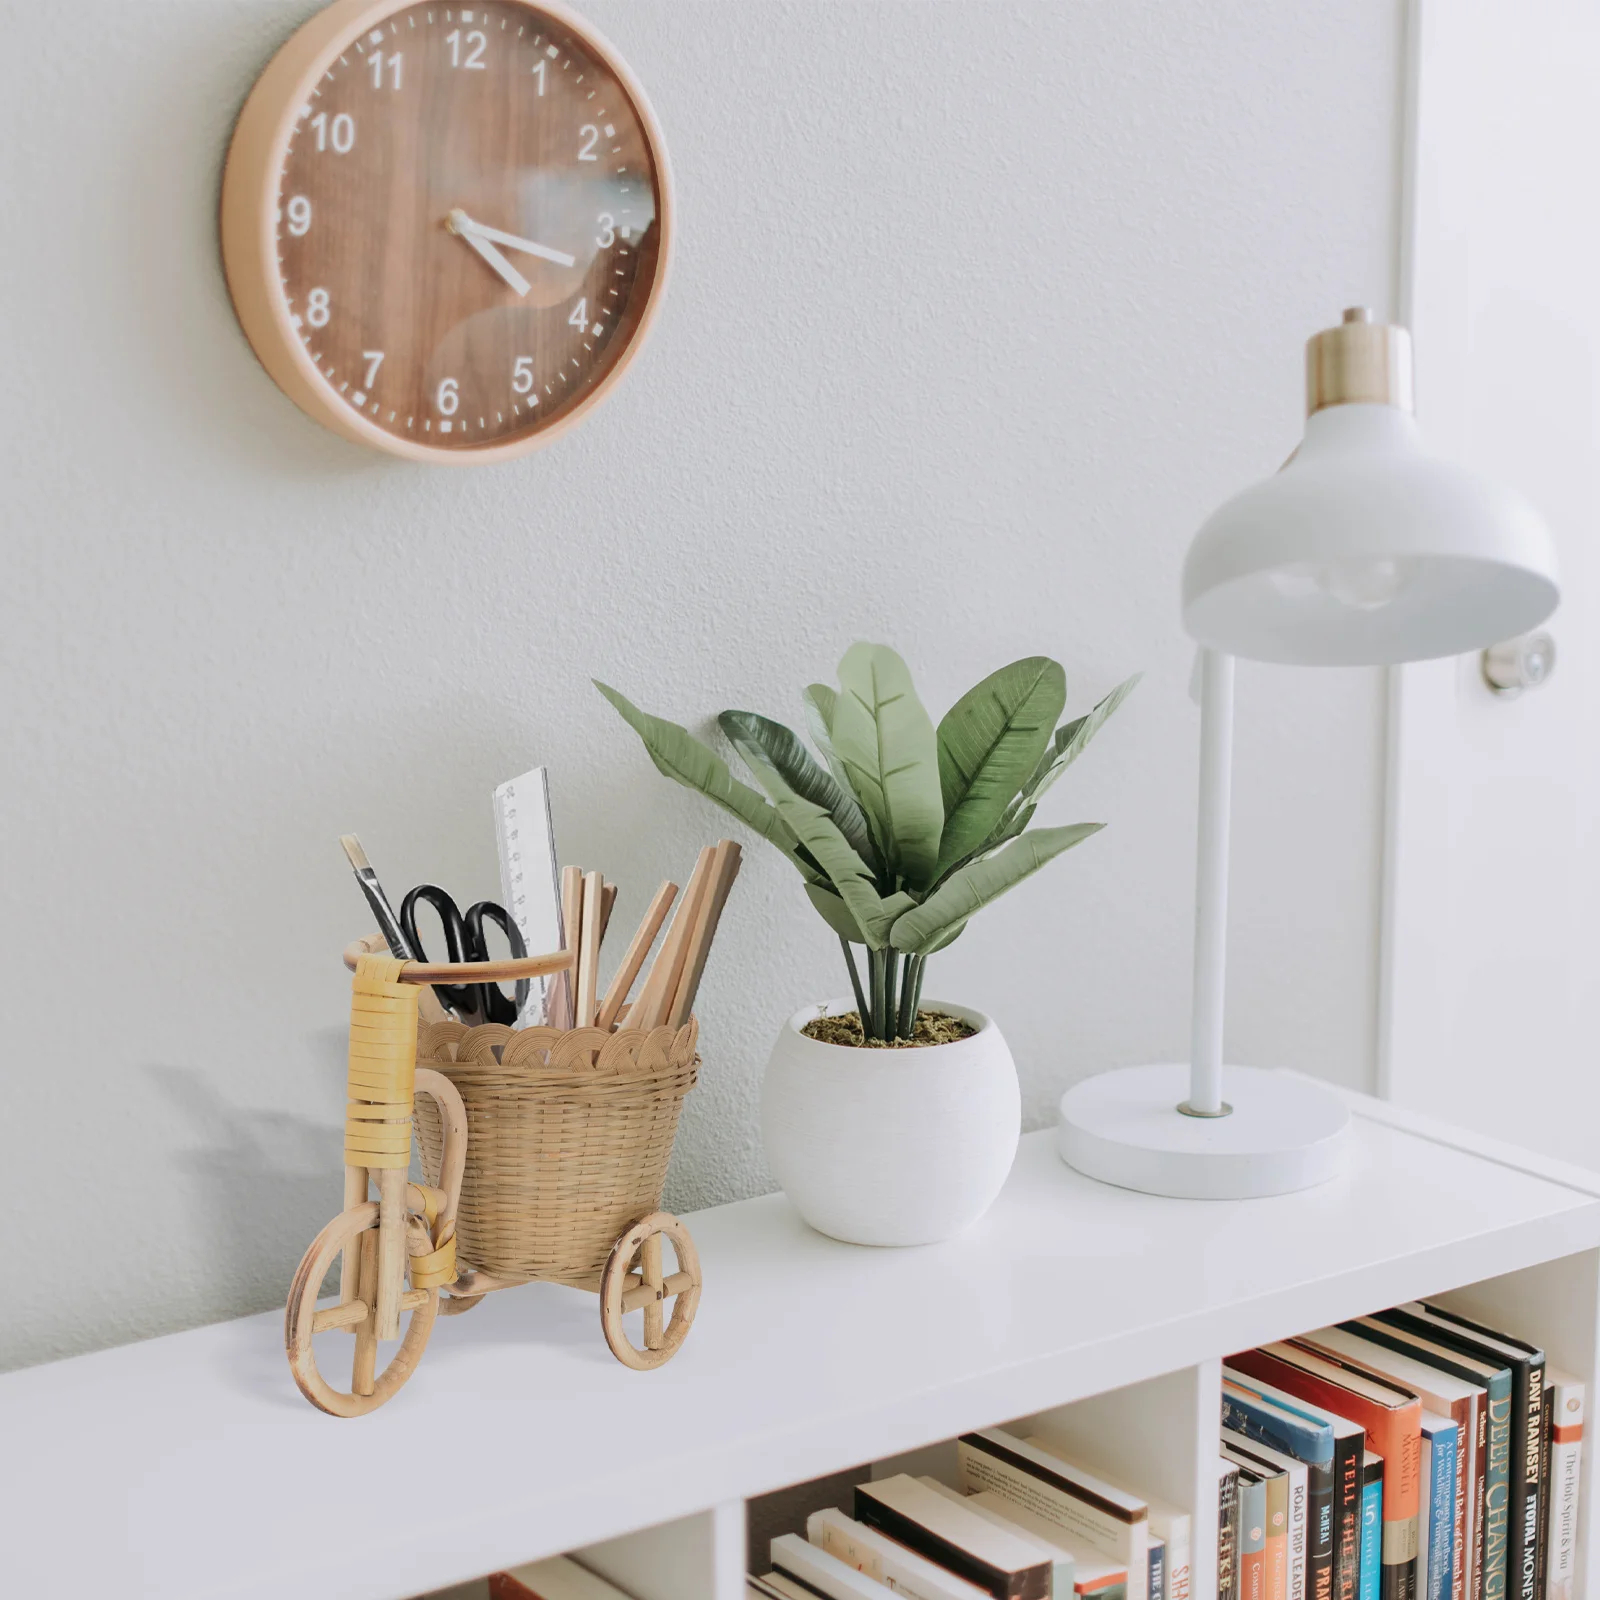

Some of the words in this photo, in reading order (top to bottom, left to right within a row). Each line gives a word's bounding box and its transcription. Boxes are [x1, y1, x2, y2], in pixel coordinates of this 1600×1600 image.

[447, 31, 487, 69] 12
[368, 52, 404, 90] 11
[532, 60, 547, 96] 1
[311, 113, 355, 154] 10
[578, 124, 598, 161] 2
[287, 196, 312, 236] 9
[596, 213, 614, 248] 3
[307, 288, 330, 328] 8
[569, 297, 588, 333] 4
[363, 352, 384, 388] 7
[513, 357, 533, 393] 5
[437, 378, 459, 415] 6
[1528, 1370, 1542, 1413] DAVE
[1436, 1444, 1447, 1457] for
[1457, 1423, 1466, 1446] The
[1490, 1396, 1511, 1474] DEEP
[1526, 1415, 1541, 1483] RAMSEY
[1344, 1454, 1356, 1506] TELL
[1401, 1433, 1412, 1495] MAXWELL
[1456, 1448, 1465, 1475] Nuts
[1566, 1451, 1577, 1474] The
[1434, 1458, 1445, 1507] Weddings
[1443, 1450, 1454, 1522] Contemporary
[1456, 1476, 1465, 1497] and
[1563, 1476, 1575, 1502] Holy
[1294, 1485, 1304, 1523] ROAD
[1364, 1503, 1376, 1526] 5
[1435, 1509, 1444, 1520] &
[1455, 1497, 1464, 1526] Bolts
[1476, 1475, 1485, 1533] Understanding
[1561, 1504, 1573, 1536] Spirit
[1293, 1524, 1303, 1554] TRIP
[1320, 1504, 1331, 1545] McNEAL
[1342, 1513, 1355, 1557] THE
[1454, 1527, 1463, 1537] of
[1524, 1501, 1537, 1546] TOTAL
[1561, 1537, 1572, 1547] &
[1219, 1521, 1232, 1592] LIKE
[1443, 1524, 1451, 1575] Handbook
[1454, 1538, 1463, 1579] Church
[1559, 1548, 1571, 1570] You
[1292, 1556, 1303, 1600] LEADE
